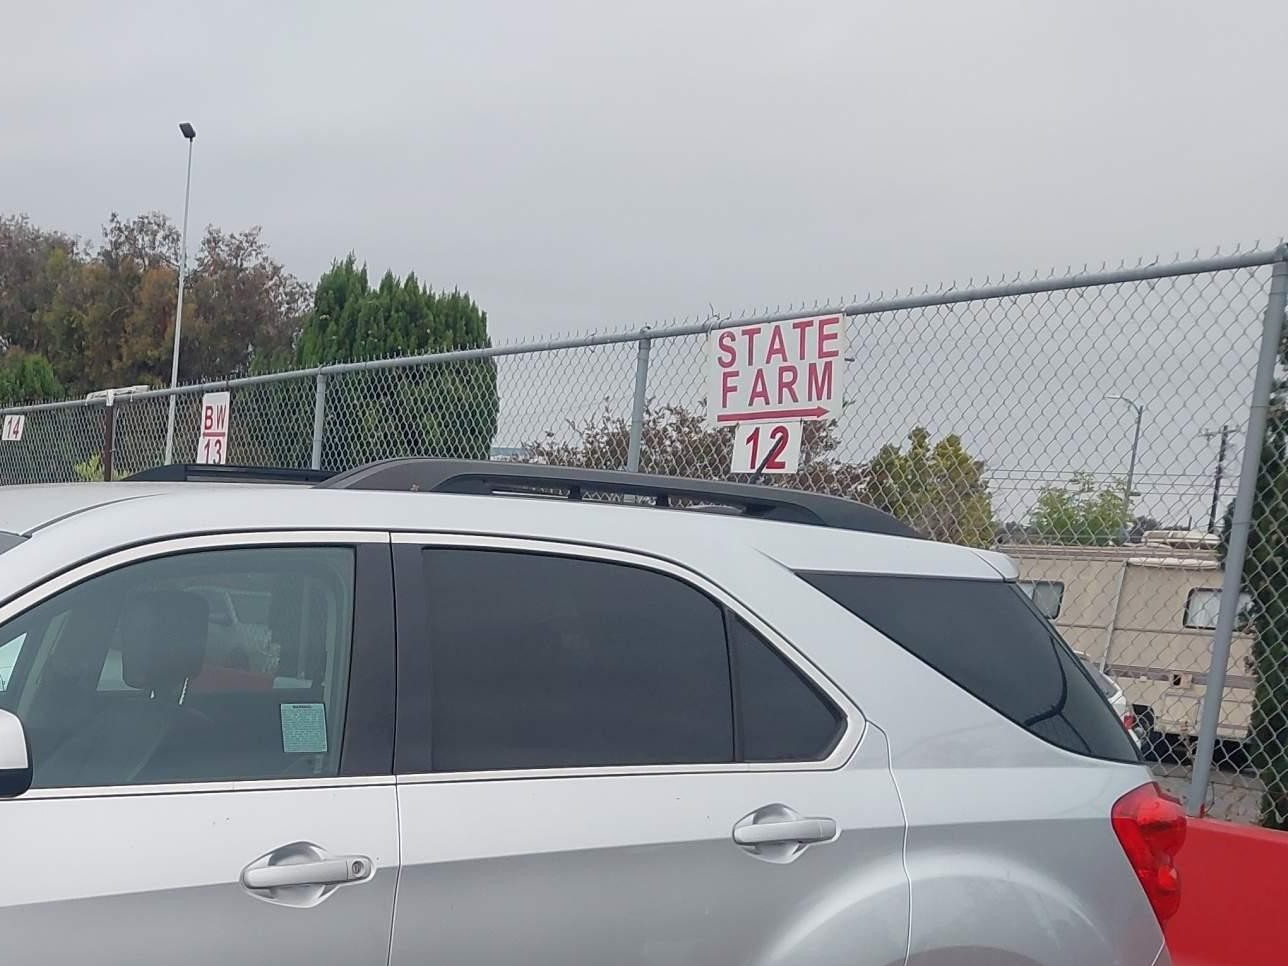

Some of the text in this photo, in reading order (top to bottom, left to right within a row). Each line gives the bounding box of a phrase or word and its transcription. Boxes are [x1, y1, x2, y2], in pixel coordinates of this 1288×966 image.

[717, 317, 840, 369] STATE
[721, 360, 833, 409] FARM
[7, 416, 21, 439] 14
[204, 404, 227, 430] BW
[203, 438, 222, 465] 13
[745, 425, 790, 470] 12
